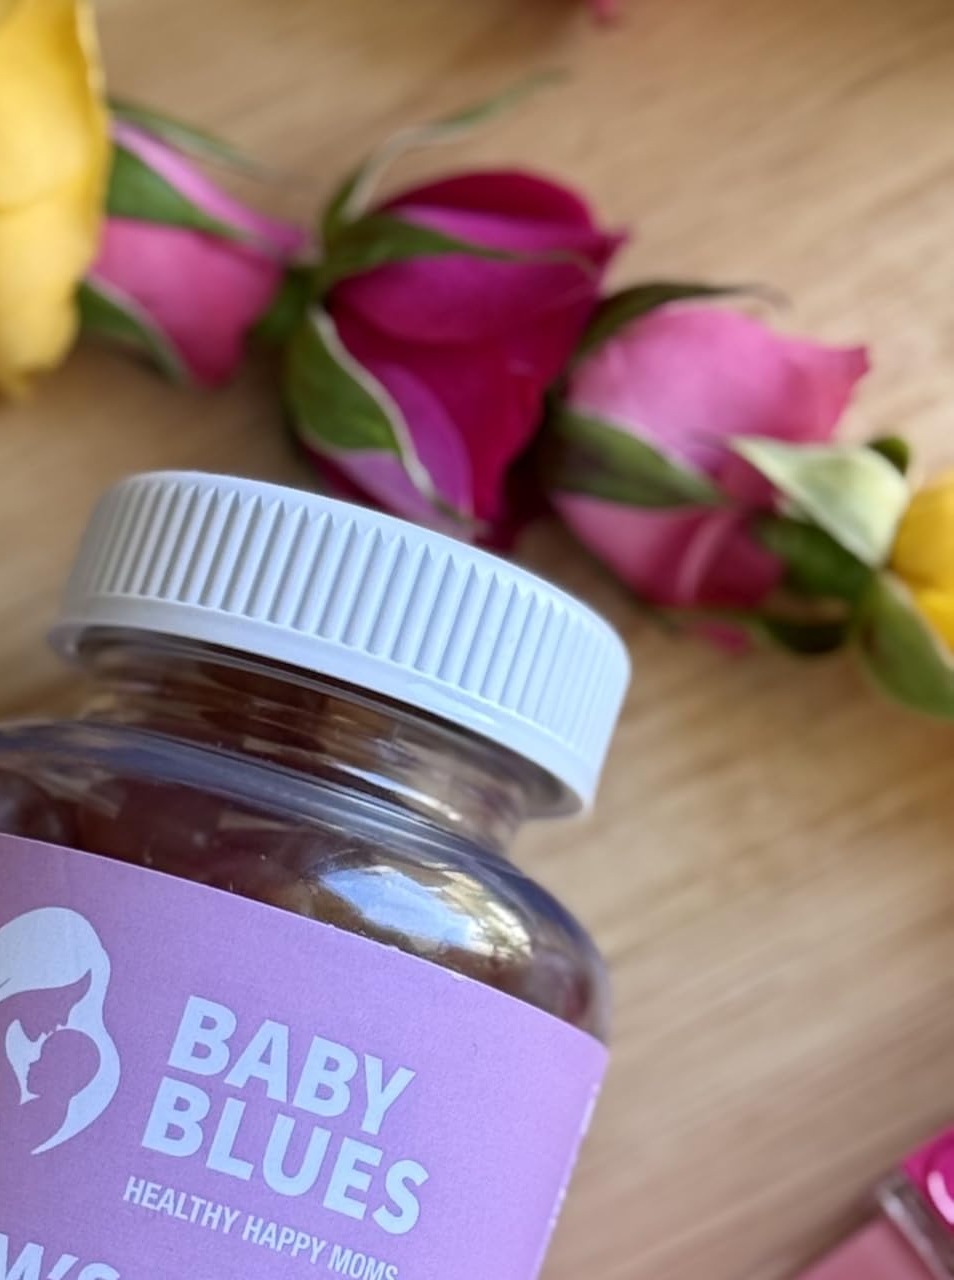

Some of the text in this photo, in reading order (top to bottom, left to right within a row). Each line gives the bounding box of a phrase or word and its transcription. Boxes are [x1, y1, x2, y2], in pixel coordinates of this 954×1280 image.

[168, 994, 416, 1136] BABY
[123, 1176, 239, 1234] HEALTHY
[242, 1217, 326, 1266] HAPPY
[141, 1076, 430, 1235] BLUES
